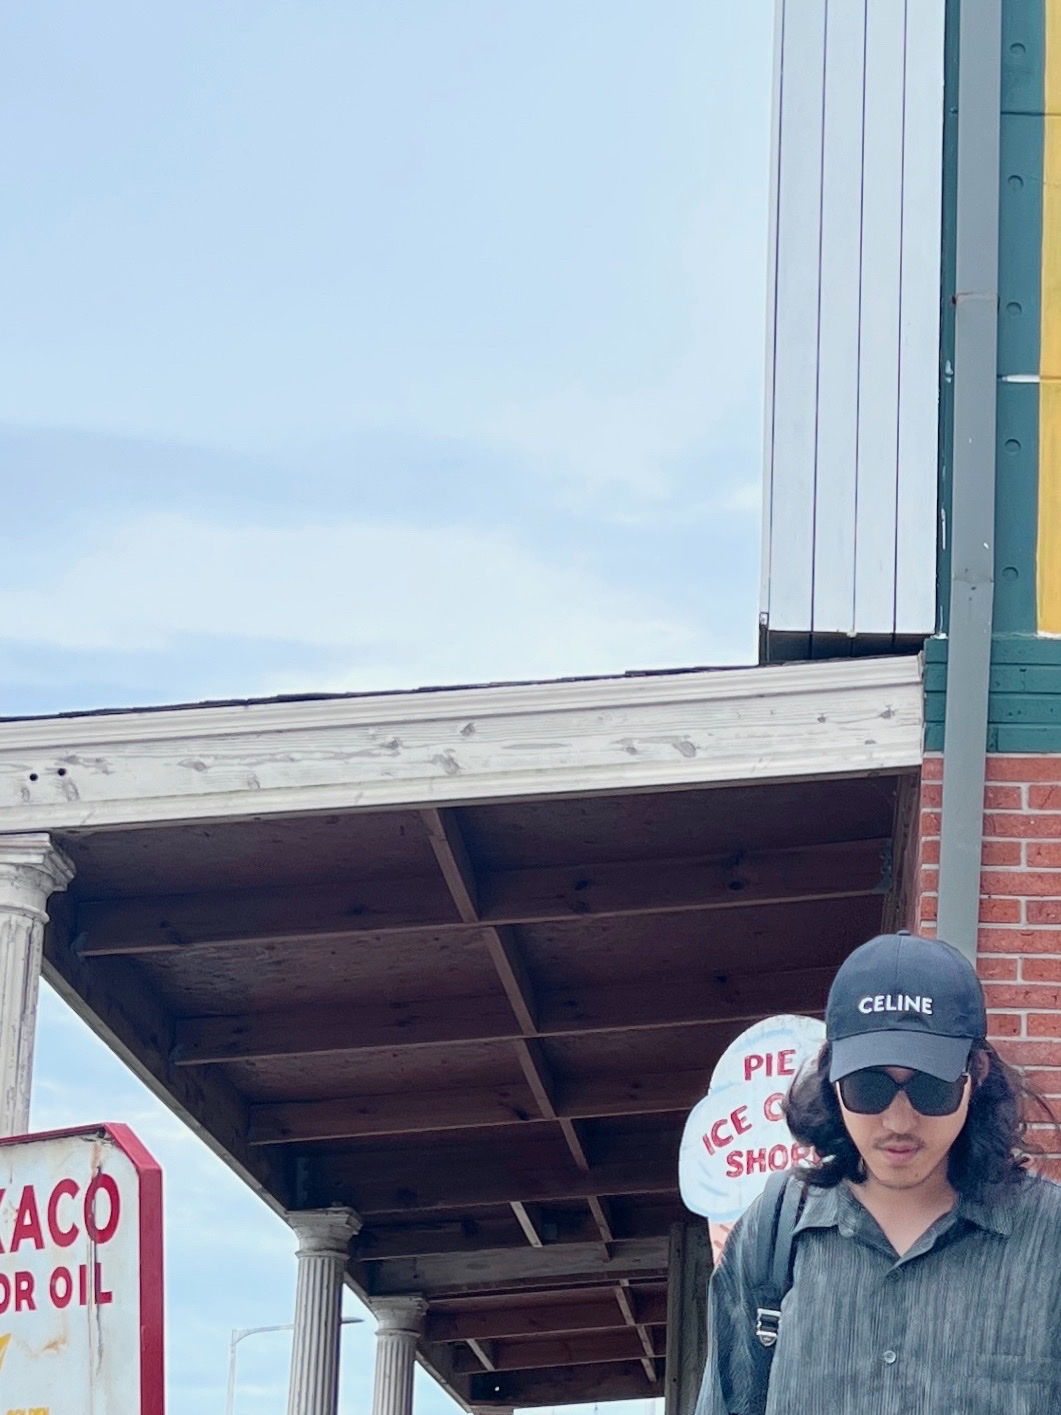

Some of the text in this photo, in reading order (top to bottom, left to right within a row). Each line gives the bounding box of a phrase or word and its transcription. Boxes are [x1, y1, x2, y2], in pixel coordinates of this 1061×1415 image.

[858, 994, 933, 1015] CELINE
[744, 1049, 796, 1081] PIE
[702, 1105, 753, 1156] ICE
[50, 1262, 112, 1309] OIL
